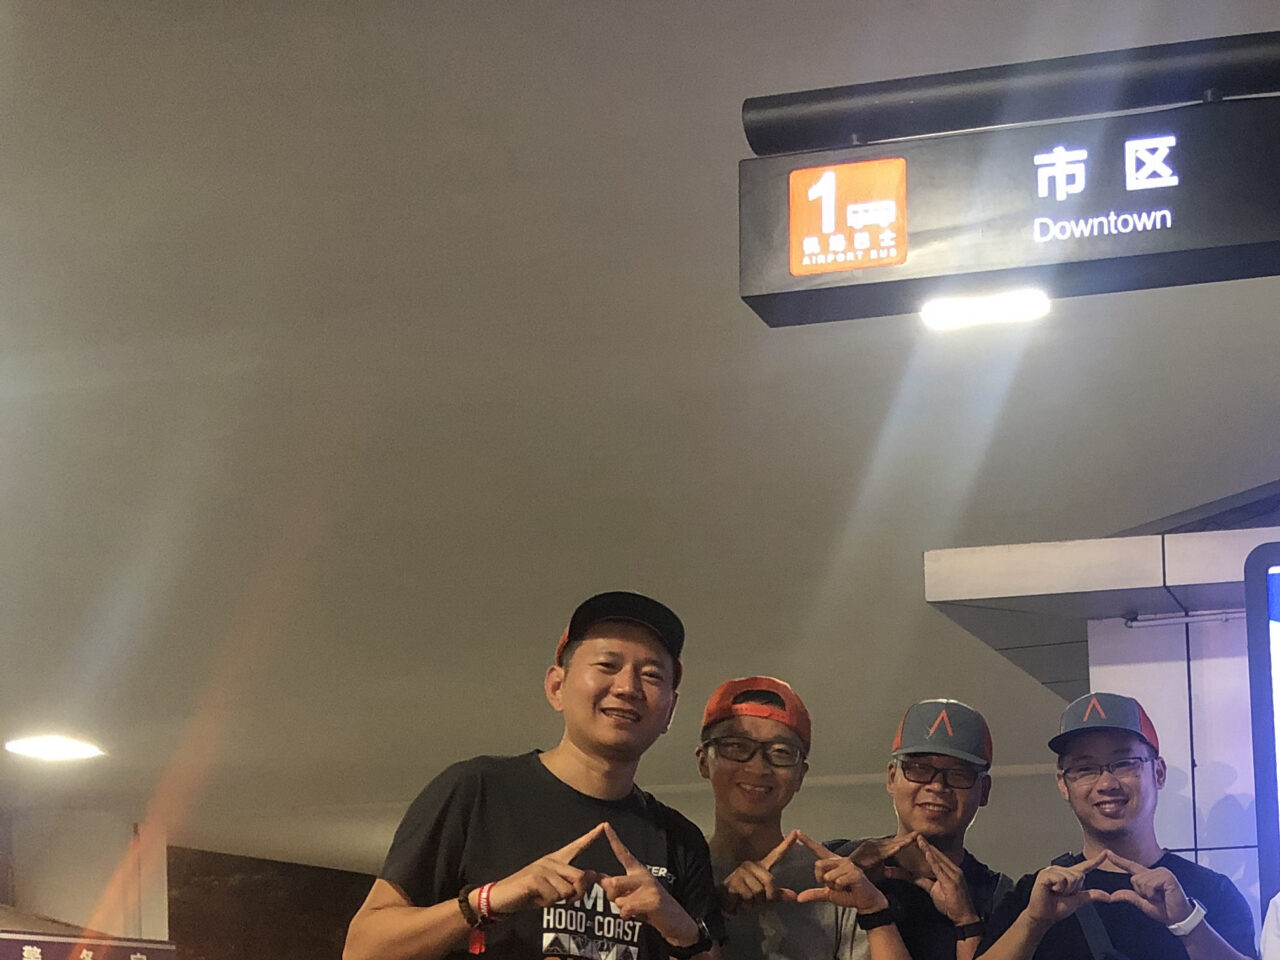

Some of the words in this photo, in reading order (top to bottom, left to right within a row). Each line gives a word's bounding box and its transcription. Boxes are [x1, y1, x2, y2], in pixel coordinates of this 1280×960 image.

[1033, 135, 1179, 201] 市区
[807, 170, 836, 234] 1
[1033, 206, 1172, 243] Downtown
[802, 251, 864, 265] AIRPORT
[542, 906, 586, 933] HOOD
[595, 915, 643, 943] COAST
